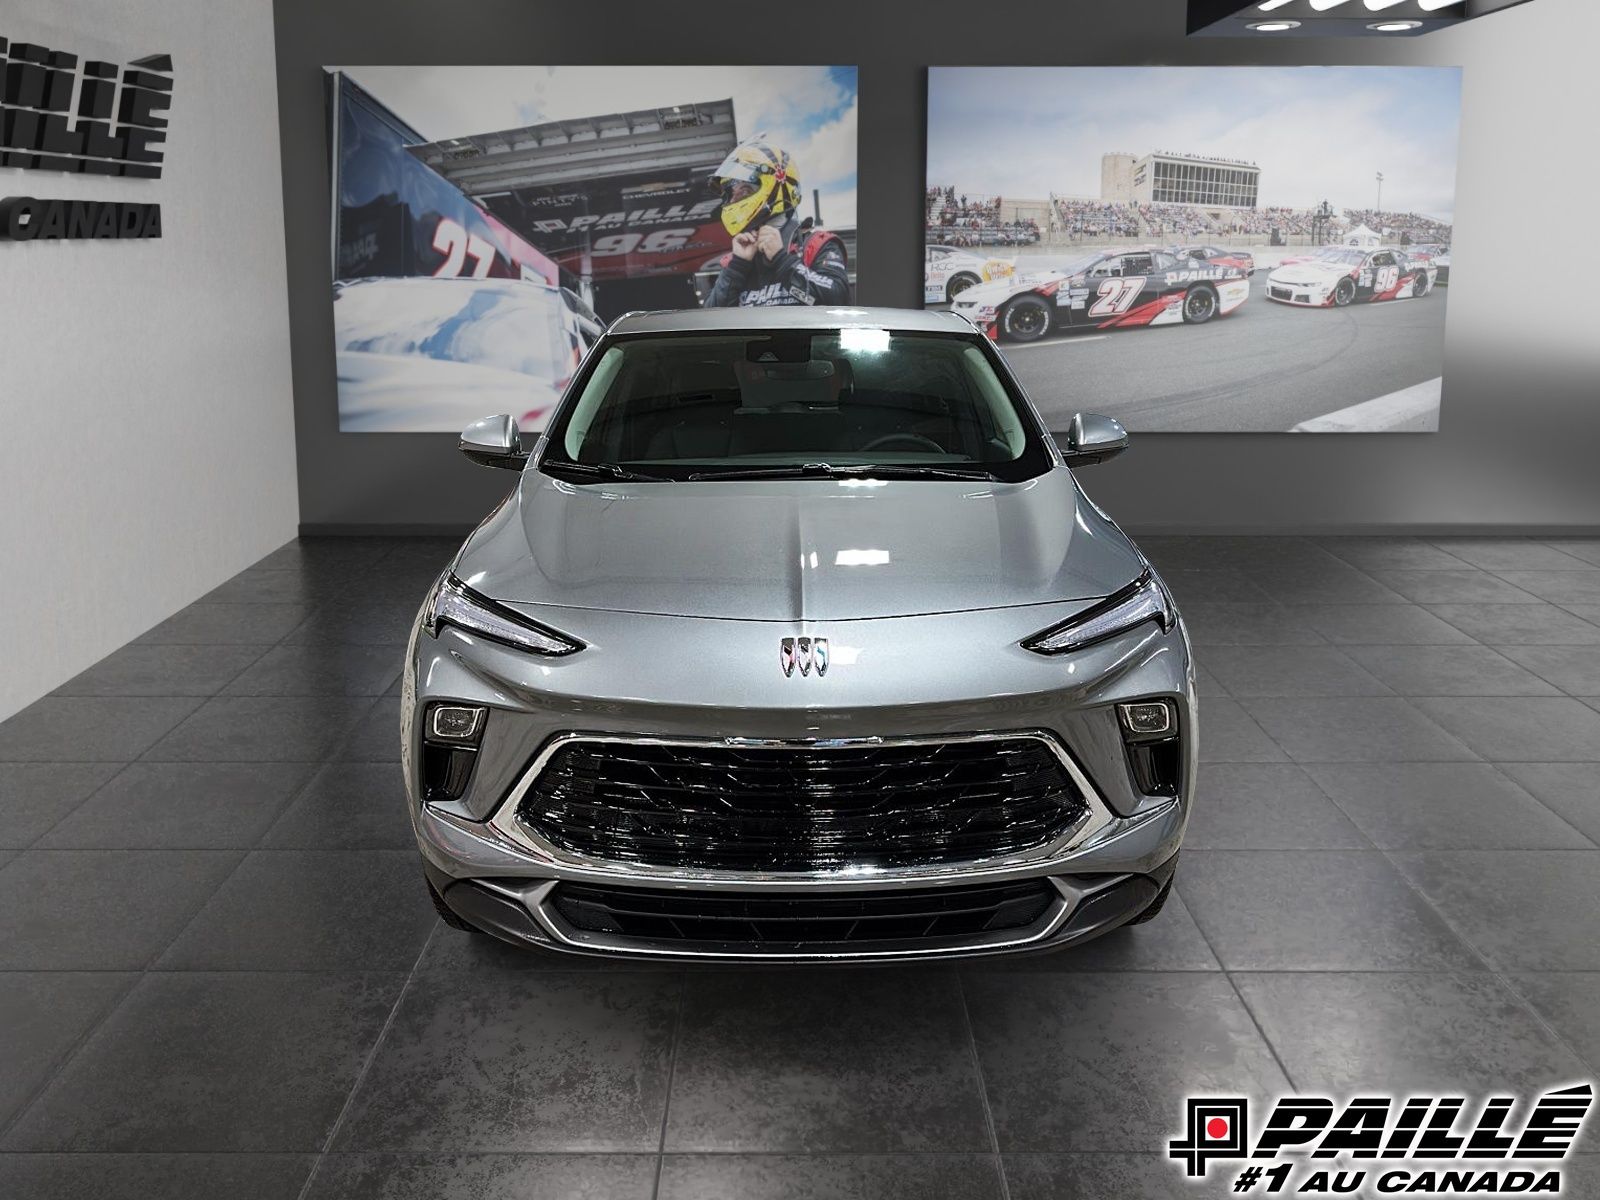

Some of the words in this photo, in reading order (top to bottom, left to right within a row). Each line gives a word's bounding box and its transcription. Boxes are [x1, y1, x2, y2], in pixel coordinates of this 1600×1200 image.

[0, 197, 162, 241] CANADA
[628, 213, 712, 227] CANADA
[432, 217, 496, 278] 27
[590, 228, 696, 257] 96
[1374, 265, 1400, 293] 96
[1088, 276, 1147, 318] 27
